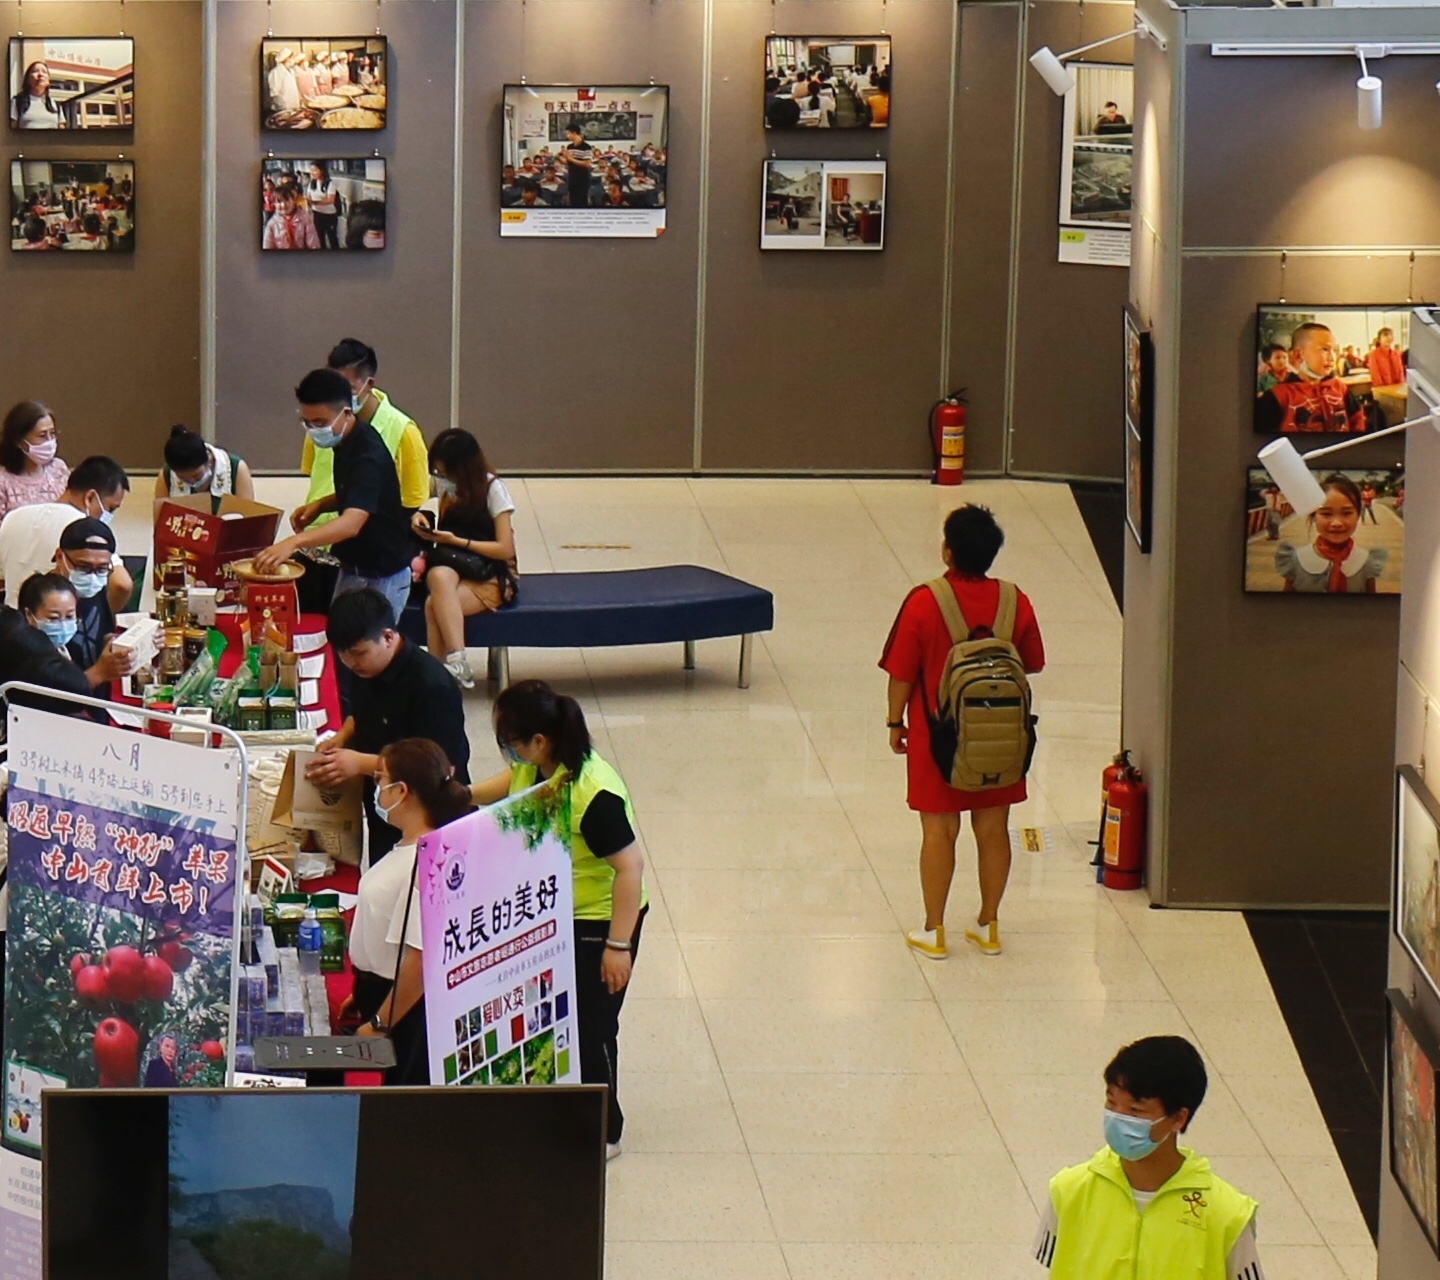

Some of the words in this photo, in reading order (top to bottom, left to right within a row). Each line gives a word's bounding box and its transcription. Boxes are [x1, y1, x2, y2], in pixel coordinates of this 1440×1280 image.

[102, 742, 142, 771] 八月
[443, 874, 558, 965] 成長的美好
